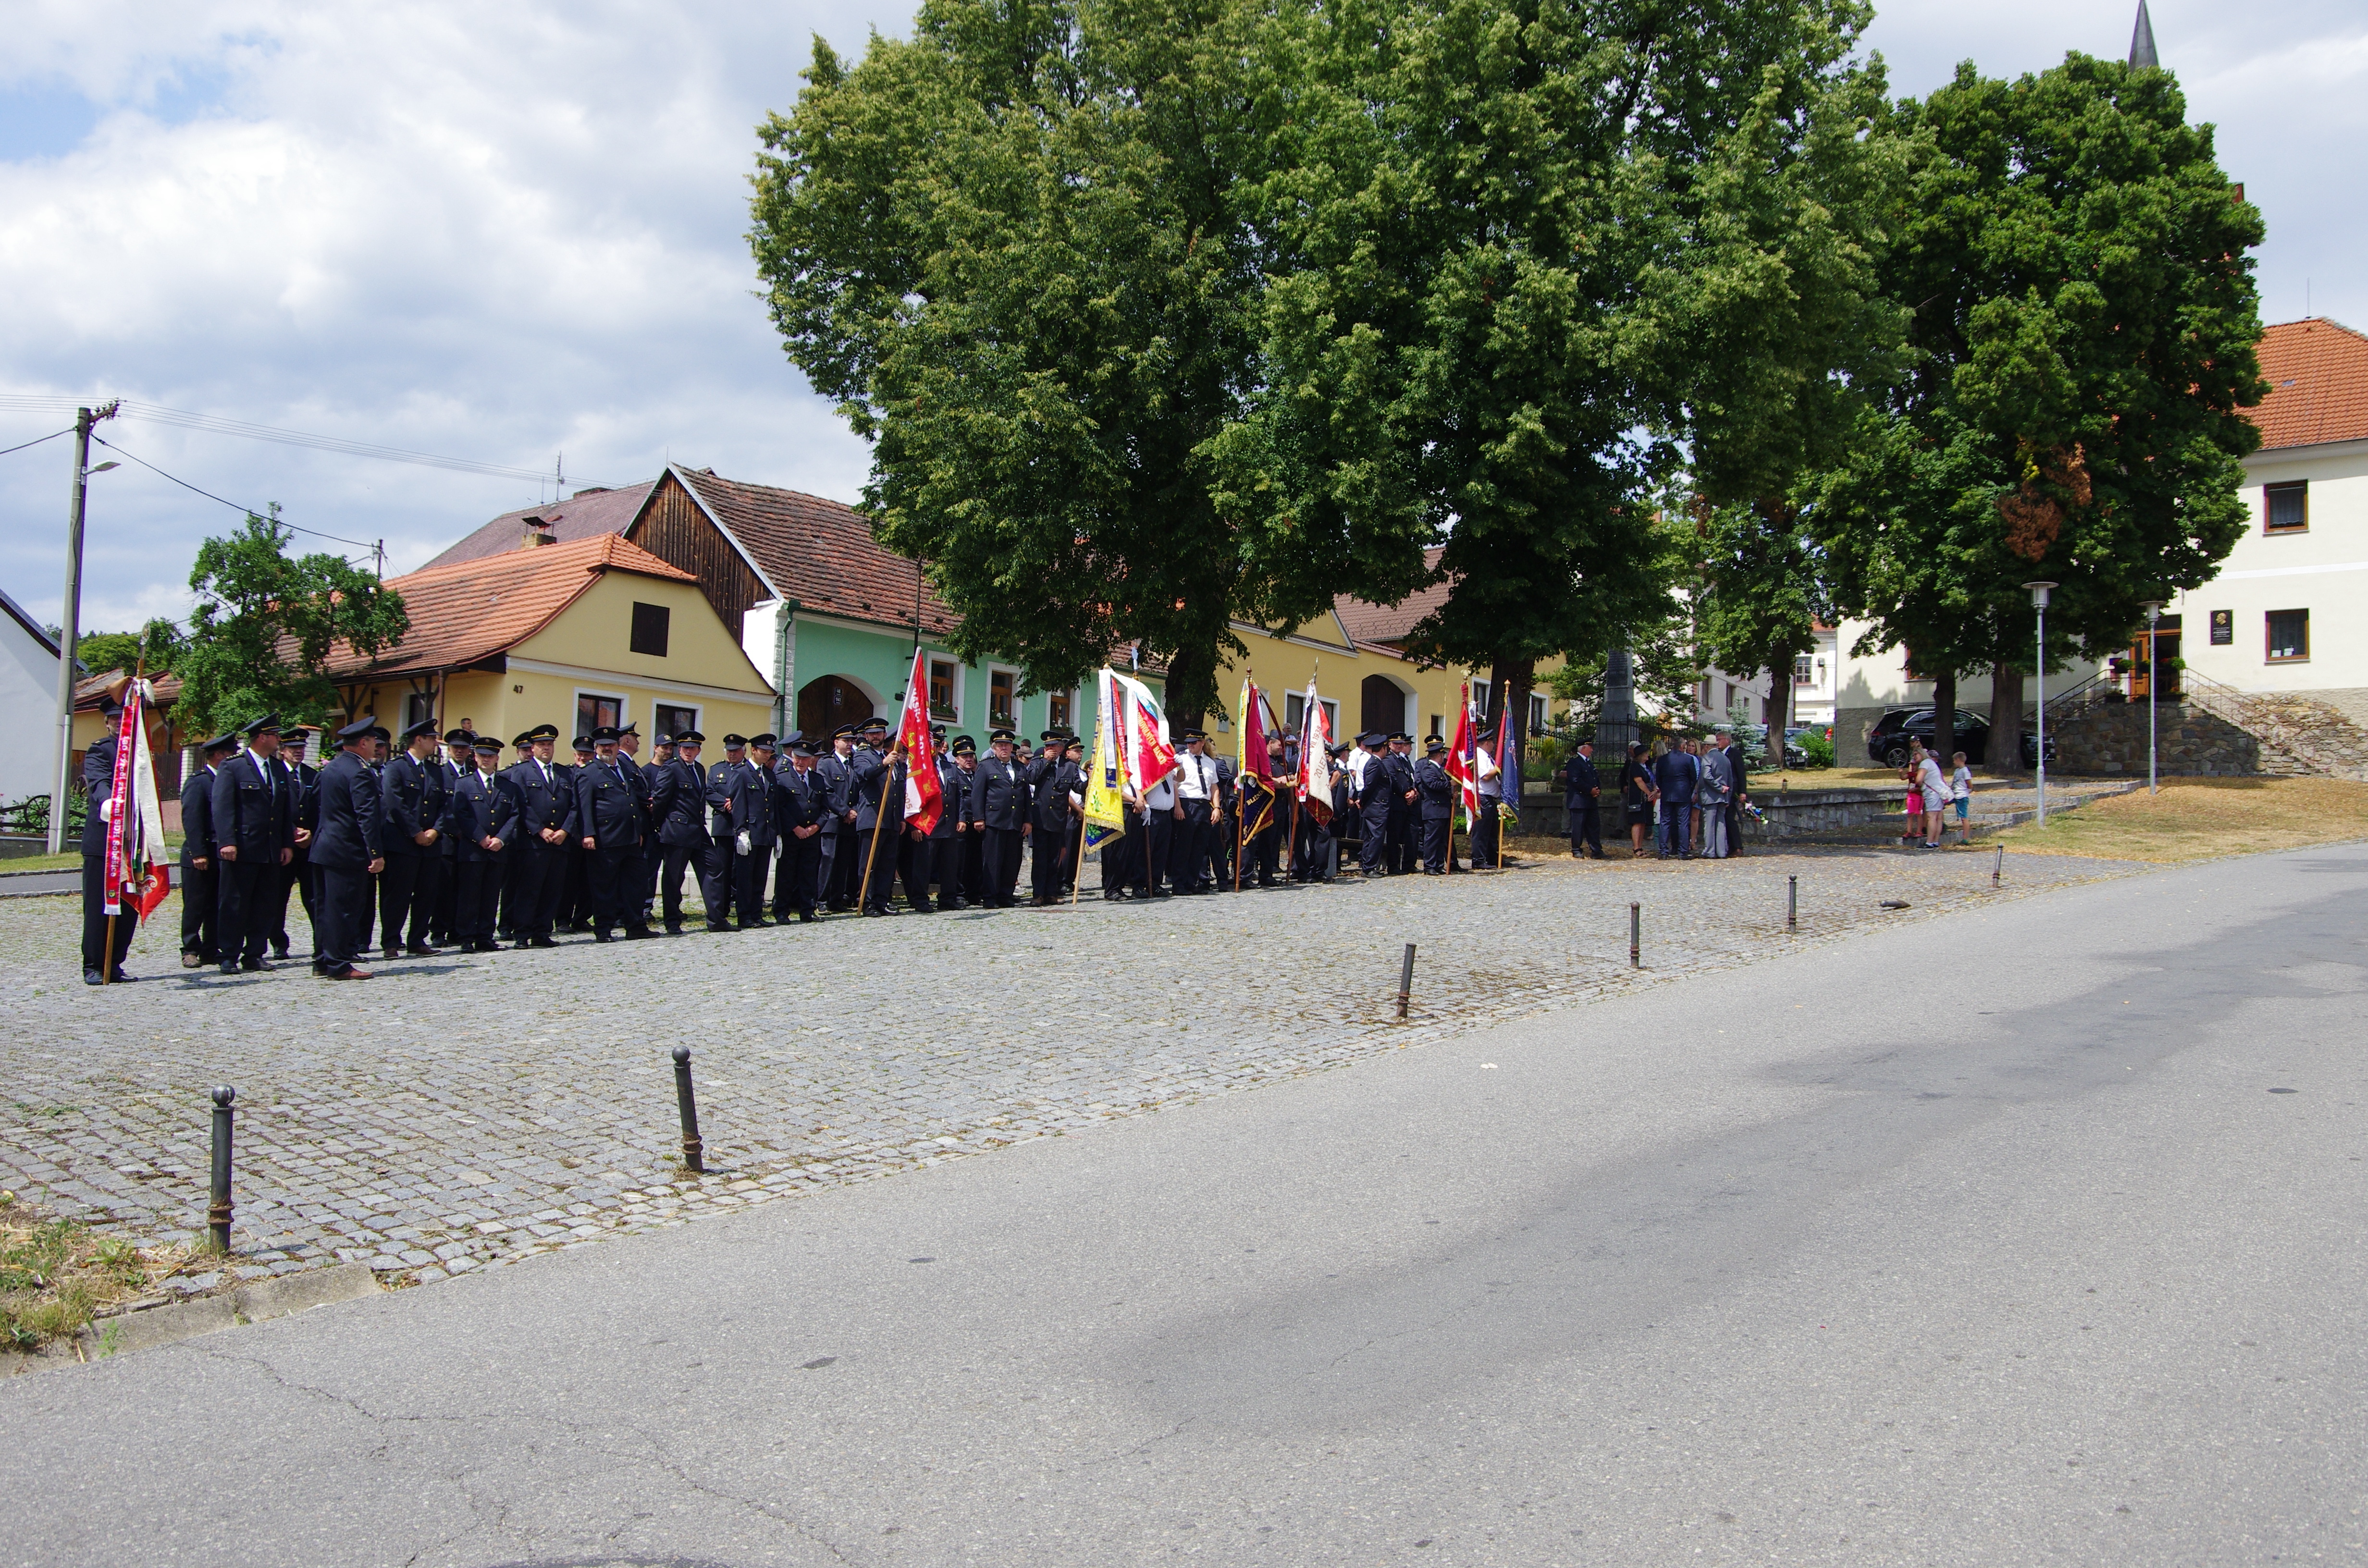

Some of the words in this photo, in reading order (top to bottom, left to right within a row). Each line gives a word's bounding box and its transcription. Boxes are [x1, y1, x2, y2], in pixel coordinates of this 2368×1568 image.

[514, 685, 523, 693] 47
[1138, 711, 1157, 747] OBROVOLNÝCH
[1313, 725, 1322, 740] 1938
[1314, 769, 1322, 778] 20
[1318, 756, 1327, 770] LET
[113, 819, 121, 837] SDH
[111, 840, 120, 877] Soběšice
